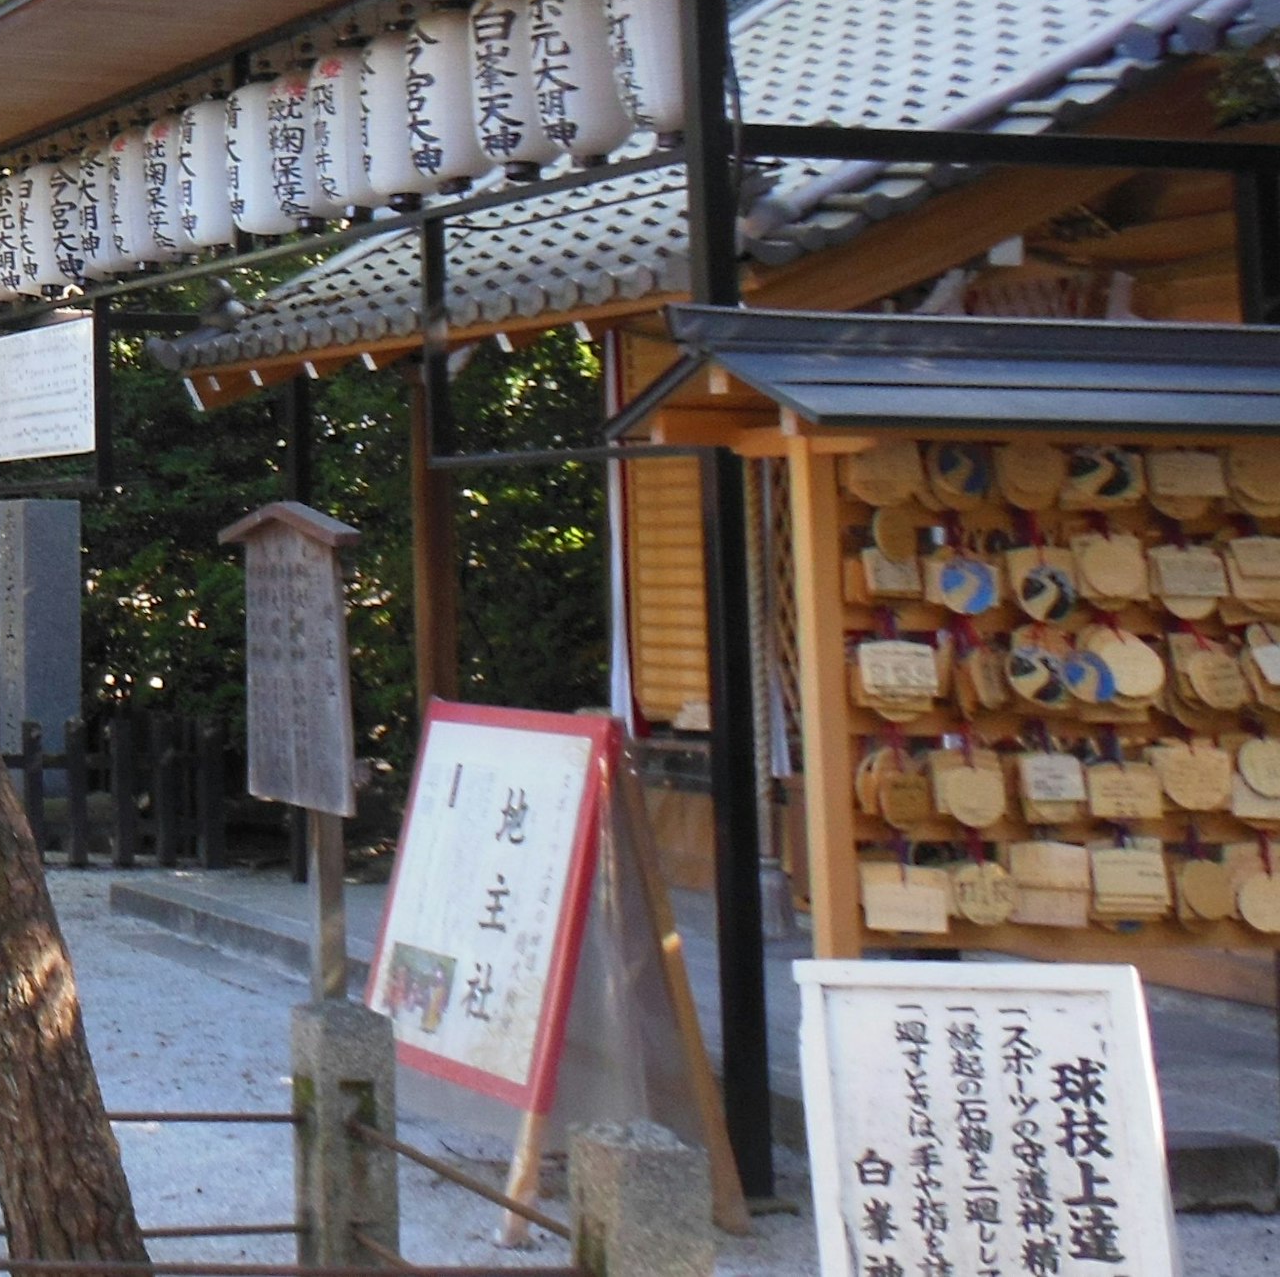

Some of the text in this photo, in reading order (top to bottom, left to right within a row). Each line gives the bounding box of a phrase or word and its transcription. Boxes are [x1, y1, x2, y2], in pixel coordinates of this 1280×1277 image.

[460, 786, 530, 1023] 地主社
[1050, 1056, 1126, 1263] 球技上達
